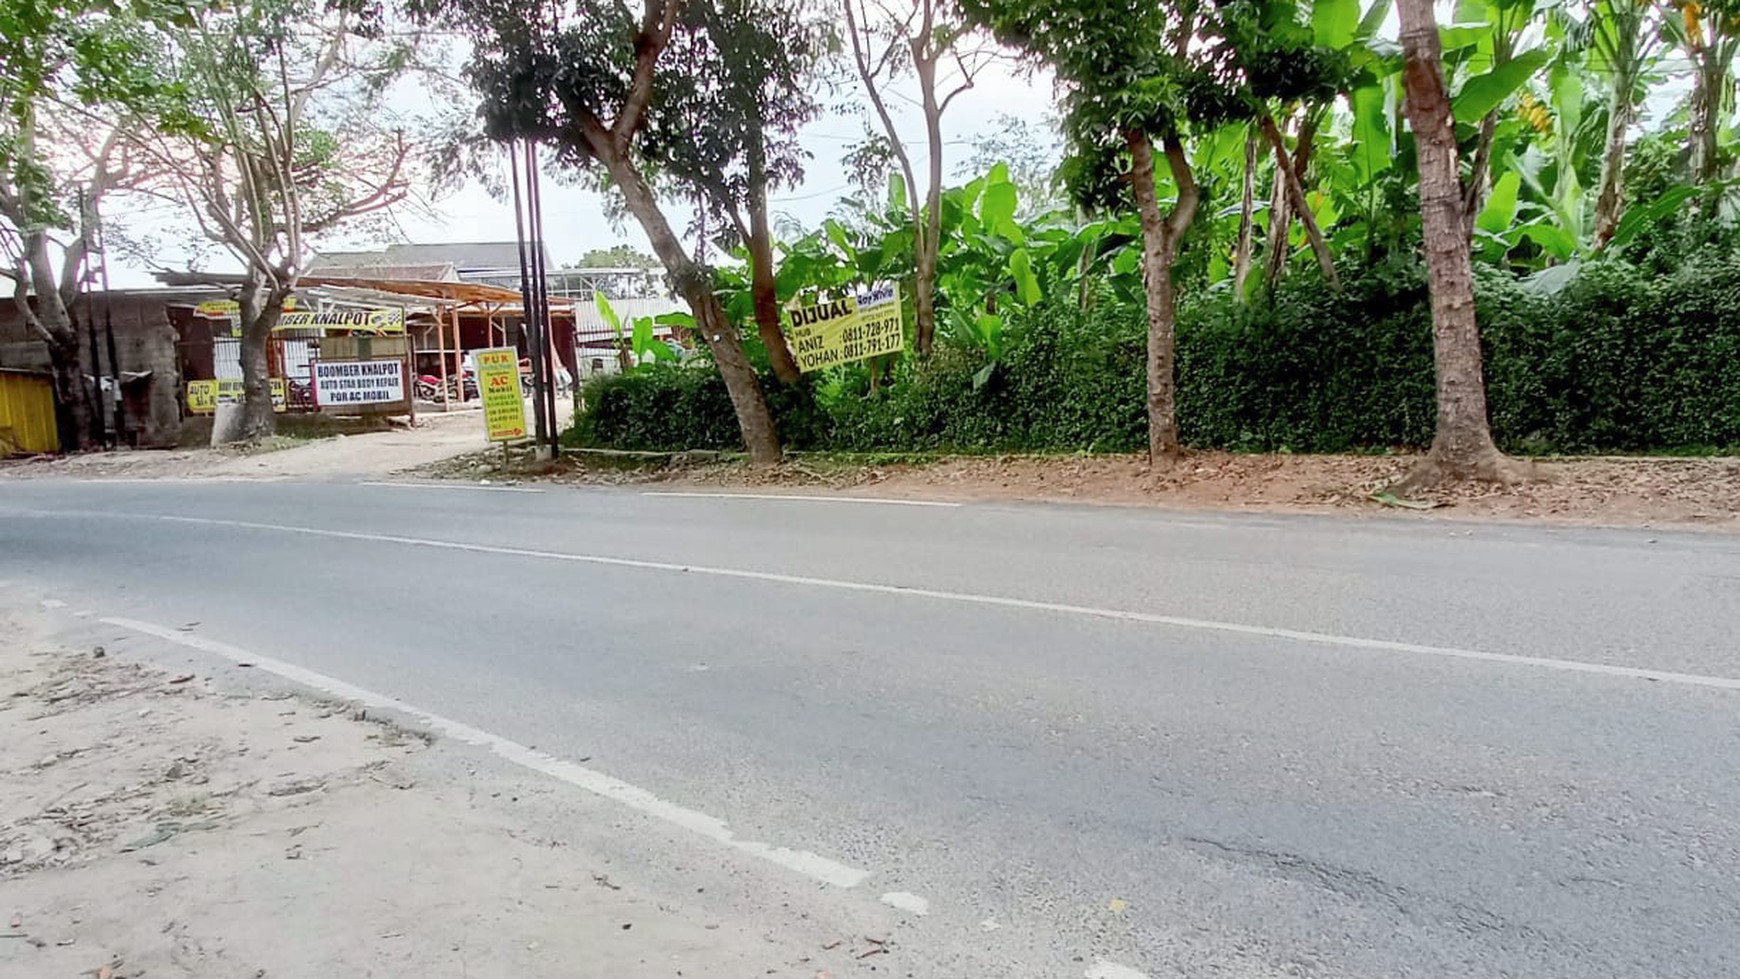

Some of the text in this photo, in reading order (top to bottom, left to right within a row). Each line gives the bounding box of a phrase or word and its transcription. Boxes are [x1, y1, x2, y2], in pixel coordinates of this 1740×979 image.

[310, 311, 372, 326] KNALPOT
[790, 300, 852, 328] DIJUAL
[798, 335, 825, 353] ANIZ
[800, 349, 839, 368] YOHAN
[318, 364, 360, 377] BOOMBER
[320, 380, 338, 390] AUTO
[376, 377, 399, 387] REPAIR
[491, 376, 508, 386] AC
[349, 391, 361, 401] AC
[363, 390, 390, 400] MOBIL
